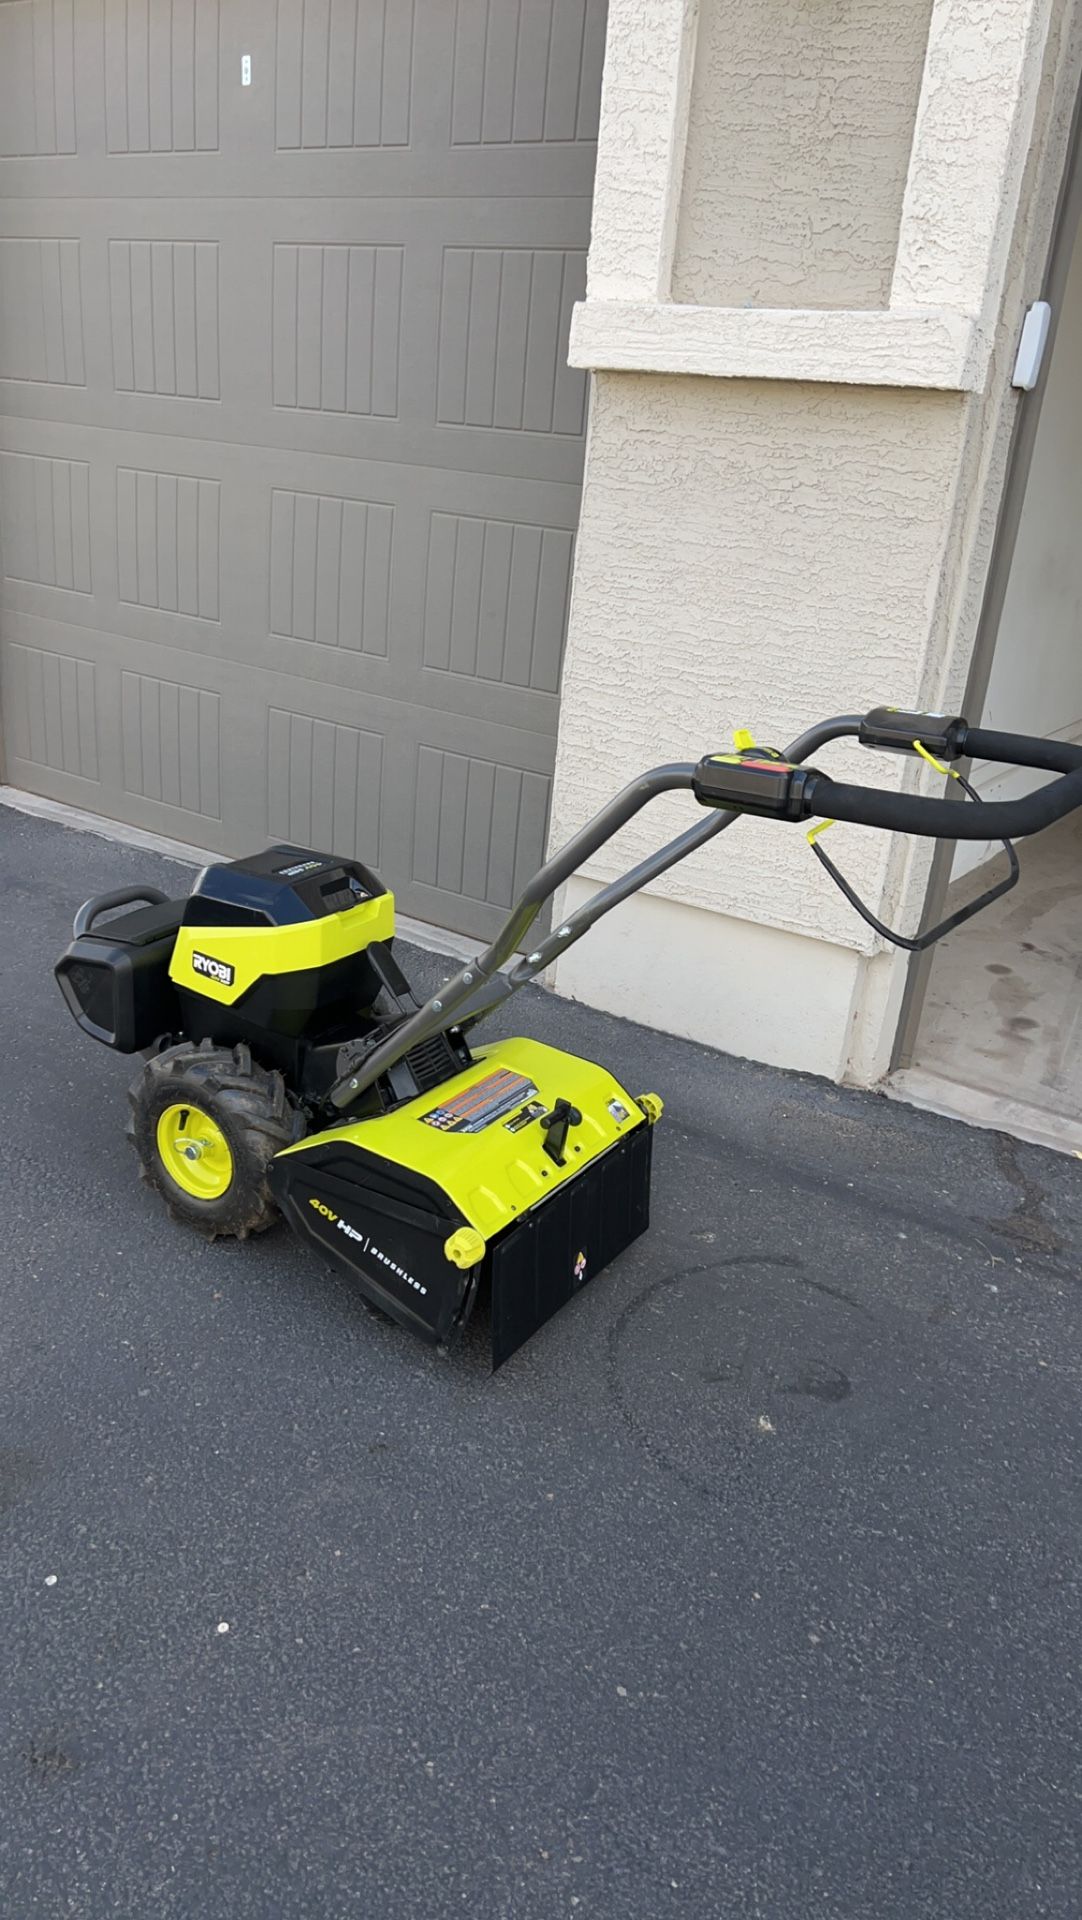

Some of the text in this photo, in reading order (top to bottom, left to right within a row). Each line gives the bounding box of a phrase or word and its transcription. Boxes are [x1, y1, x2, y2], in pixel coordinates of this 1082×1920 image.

[193, 953, 231, 981] RYOBI
[309, 1199, 427, 1295] 40V HP BRUSHLESS
